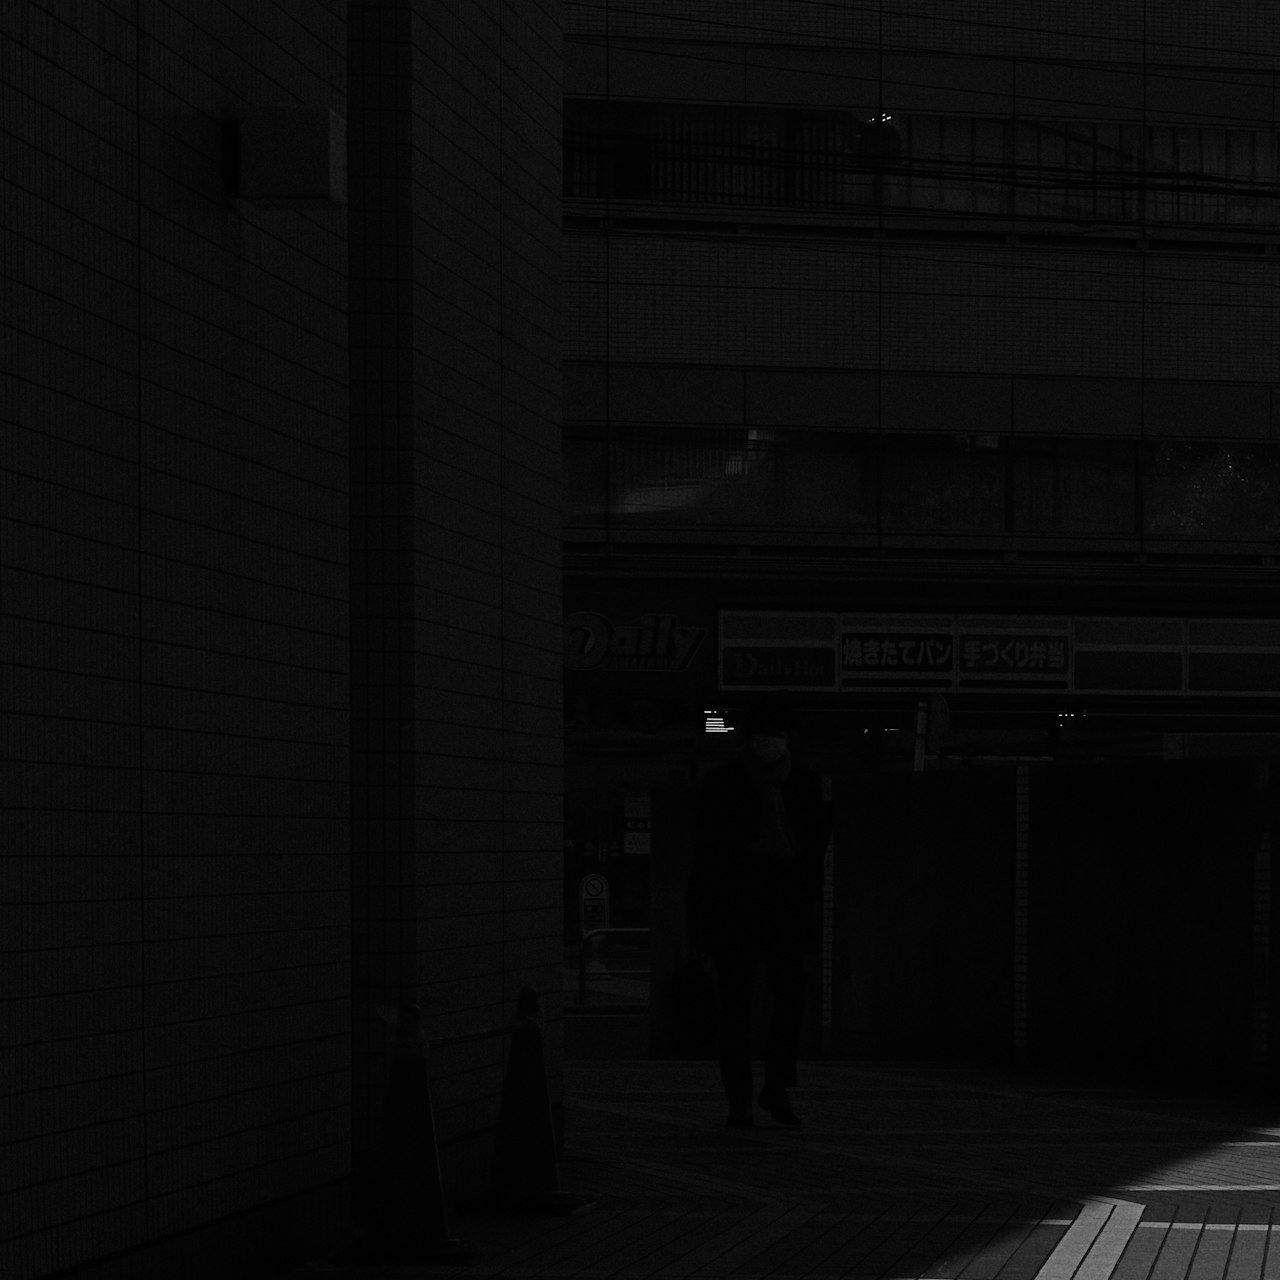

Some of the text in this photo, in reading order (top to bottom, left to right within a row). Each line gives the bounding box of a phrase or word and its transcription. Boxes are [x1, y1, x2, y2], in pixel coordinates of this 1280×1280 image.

[563, 613, 704, 669] Daily
[963, 641, 1063, 667] 手づくり弁当
